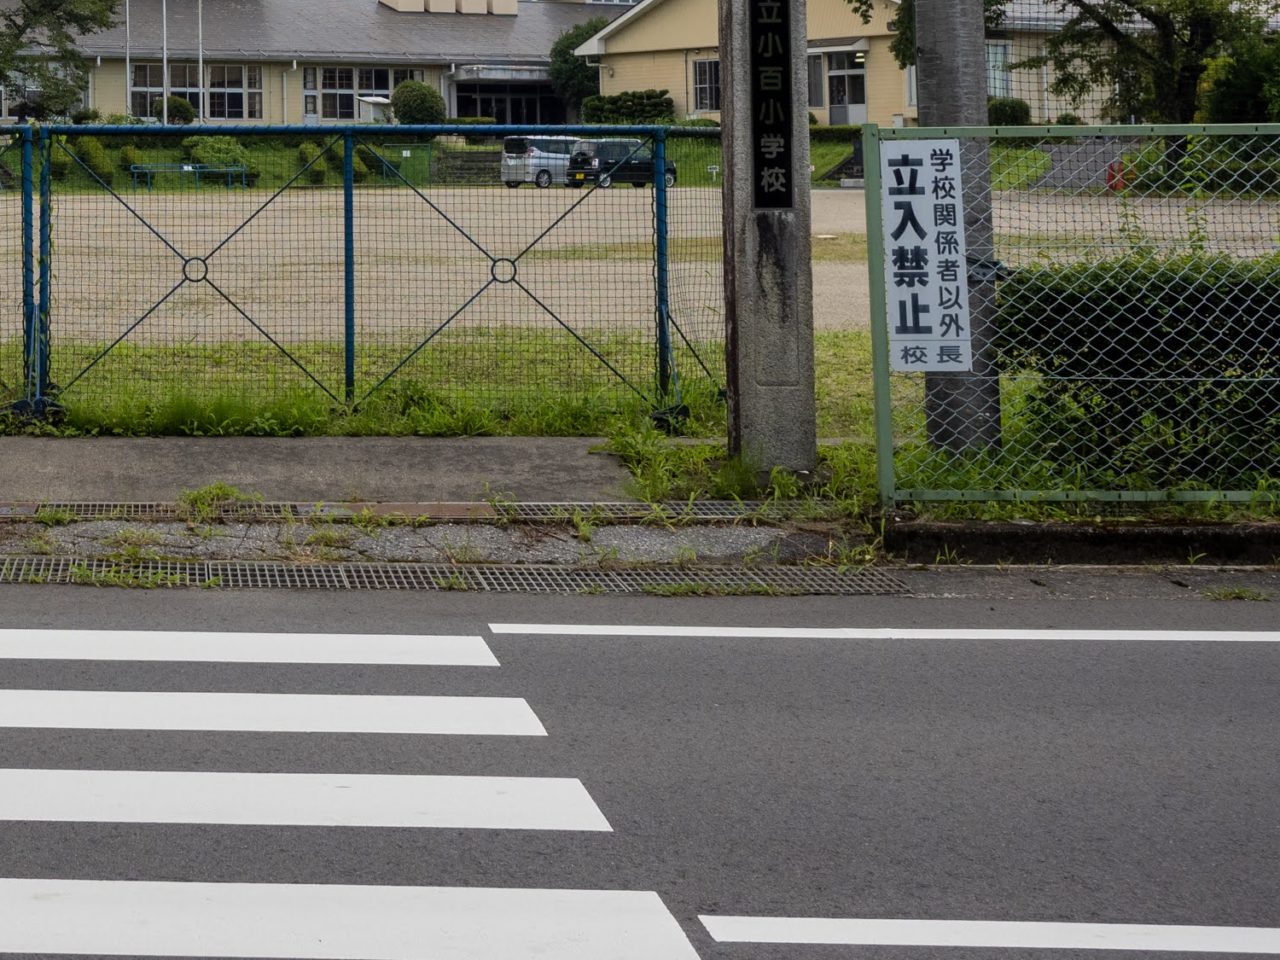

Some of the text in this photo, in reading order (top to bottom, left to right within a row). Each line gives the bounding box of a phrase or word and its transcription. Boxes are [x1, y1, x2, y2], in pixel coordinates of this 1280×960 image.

[888, 154, 933, 335] 立入禁止
[930, 148, 964, 338] 学校関係者以外
[900, 345, 963, 365] 校長
